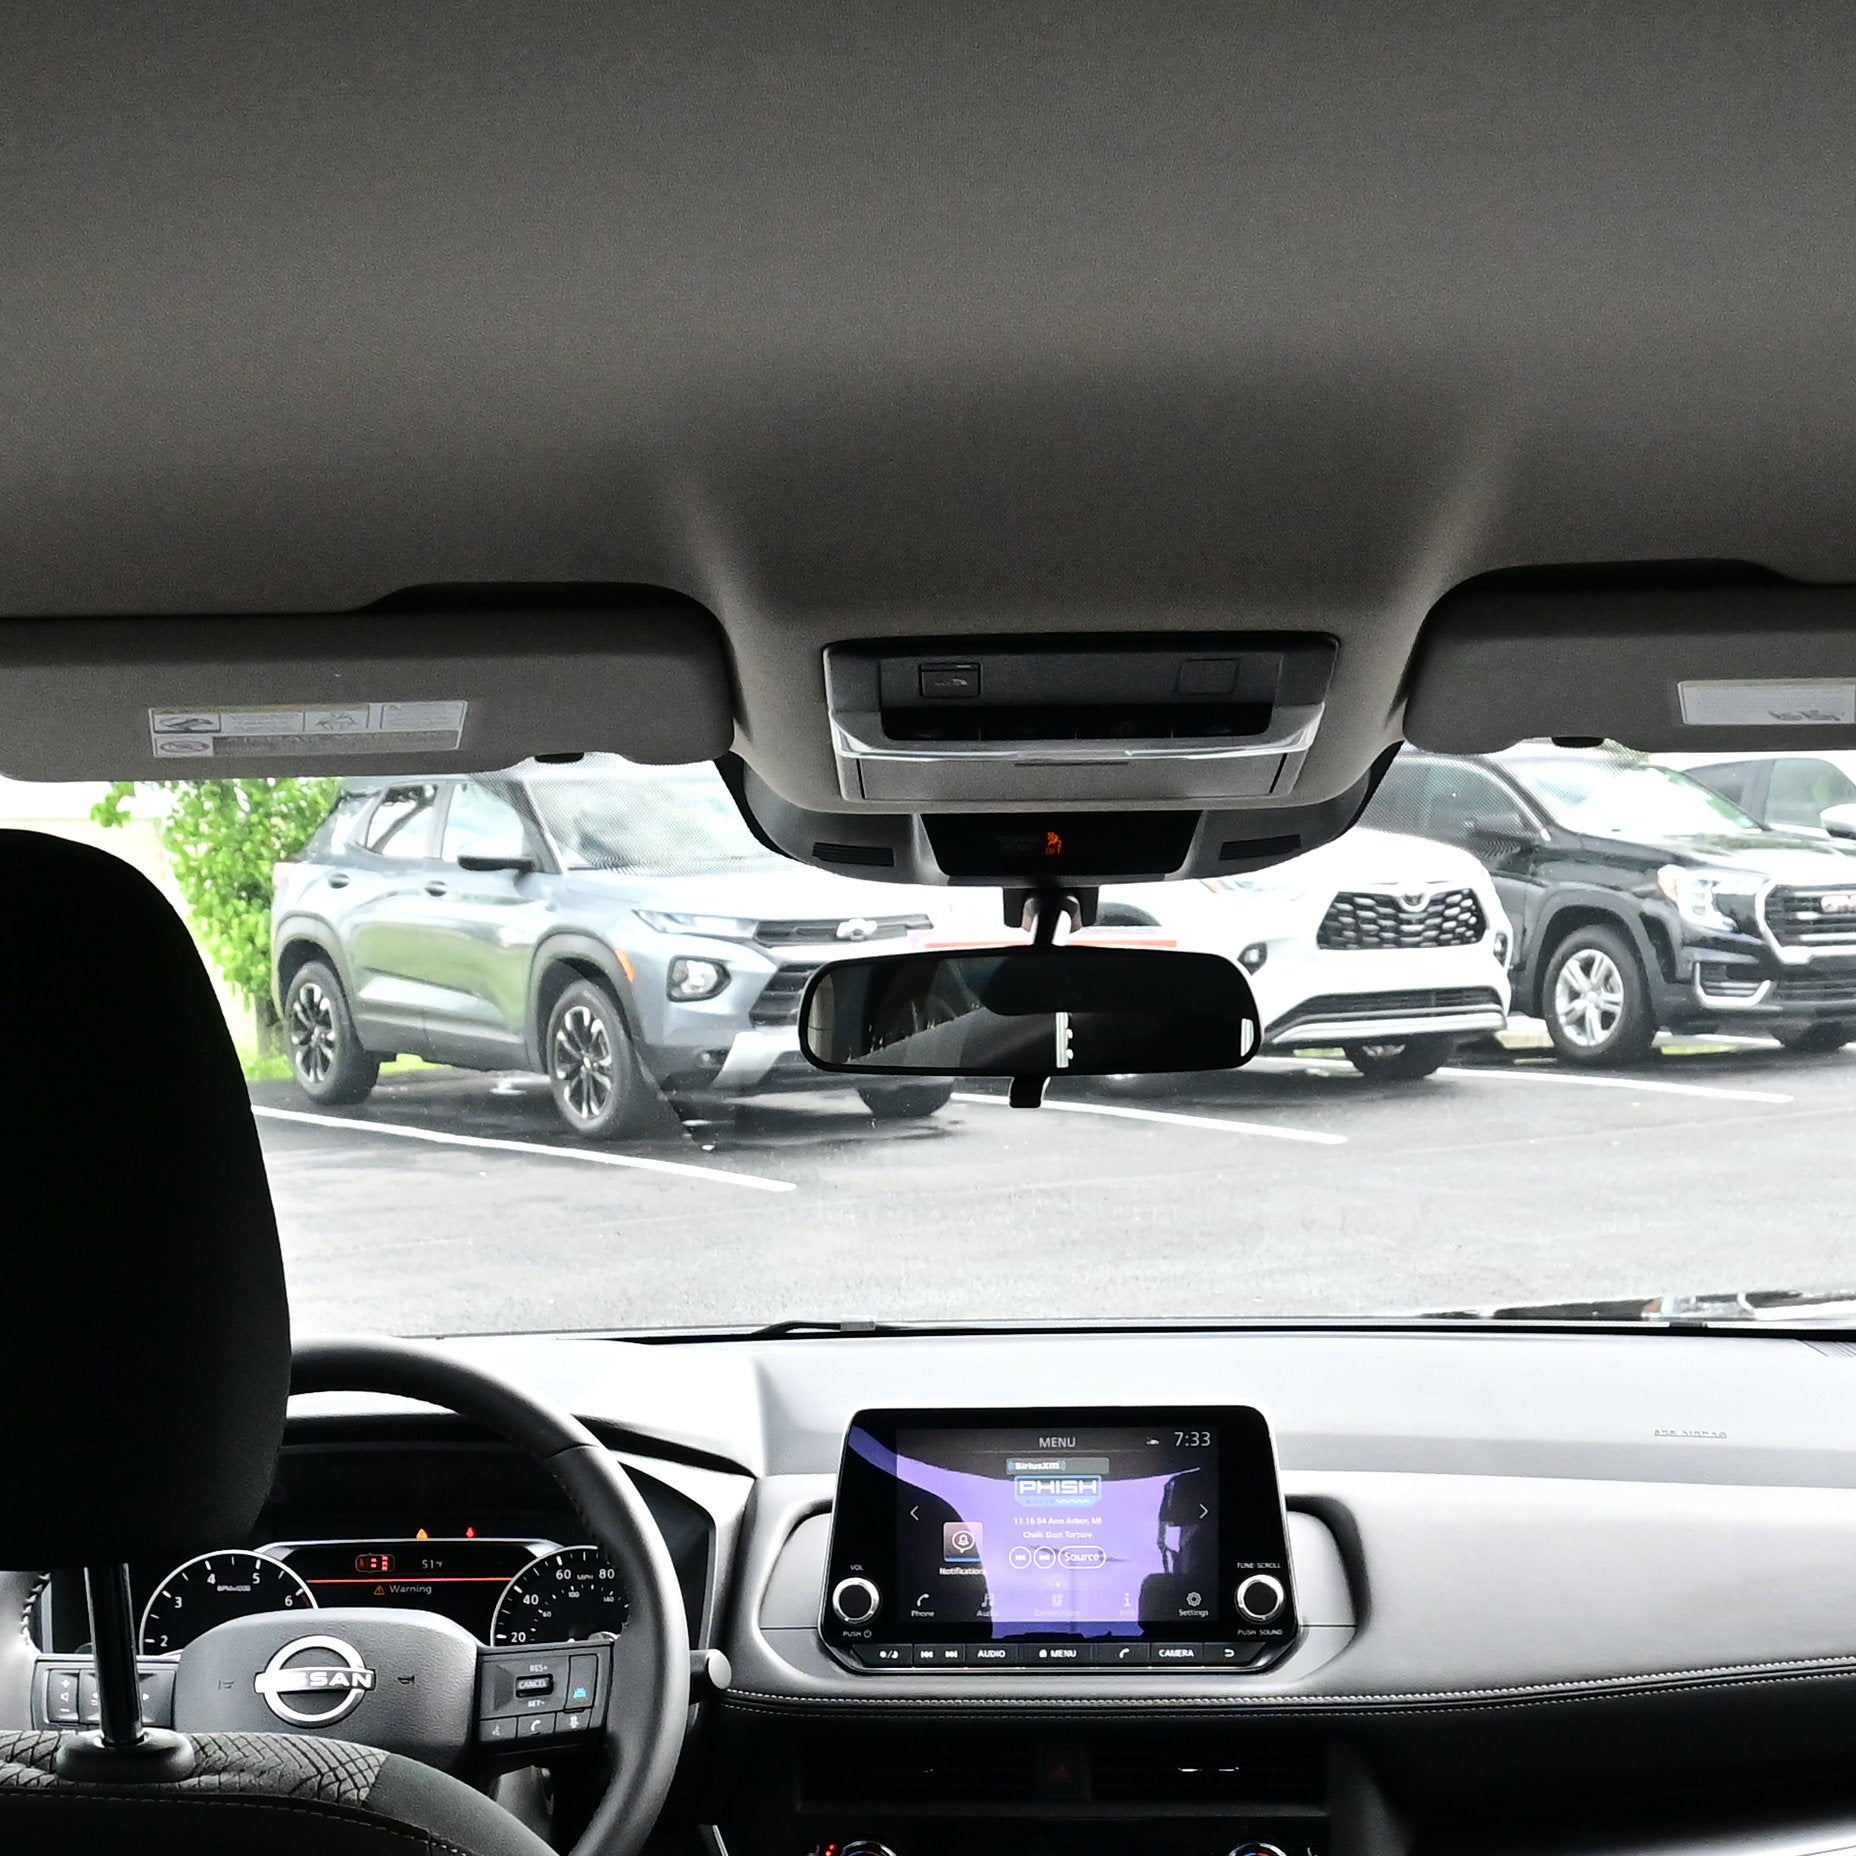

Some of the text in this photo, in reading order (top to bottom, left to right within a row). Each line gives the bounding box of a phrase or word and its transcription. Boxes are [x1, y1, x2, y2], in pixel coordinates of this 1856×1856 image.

[1038, 1436, 1077, 1449] MENU
[1173, 1431, 1211, 1448] 7:33
[1019, 1479, 1098, 1495] PHISH
[1047, 1517, 1064, 1526] Ann
[1063, 1551, 1101, 1563] Source
[206, 1573, 216, 1585] 4
[252, 1572, 261, 1584] 5
[555, 1569, 572, 1580] 60
[598, 1568, 615, 1580] 80
[388, 1584, 433, 1595] Warning
[174, 1596, 183, 1609] 3
[284, 1595, 294, 1607] 6
[522, 1593, 540, 1606] 40
[910, 1609, 935, 1618] Phone
[1178, 1608, 1210, 1619] Settings
[159, 1635, 169, 1647] 2
[510, 1631, 527, 1643] 20
[977, 1649, 1007, 1659] AUDIO
[1049, 1648, 1077, 1658] MENU
[1158, 1648, 1195, 1658] CAMERA
[518, 1679, 547, 1689] CANCEL
